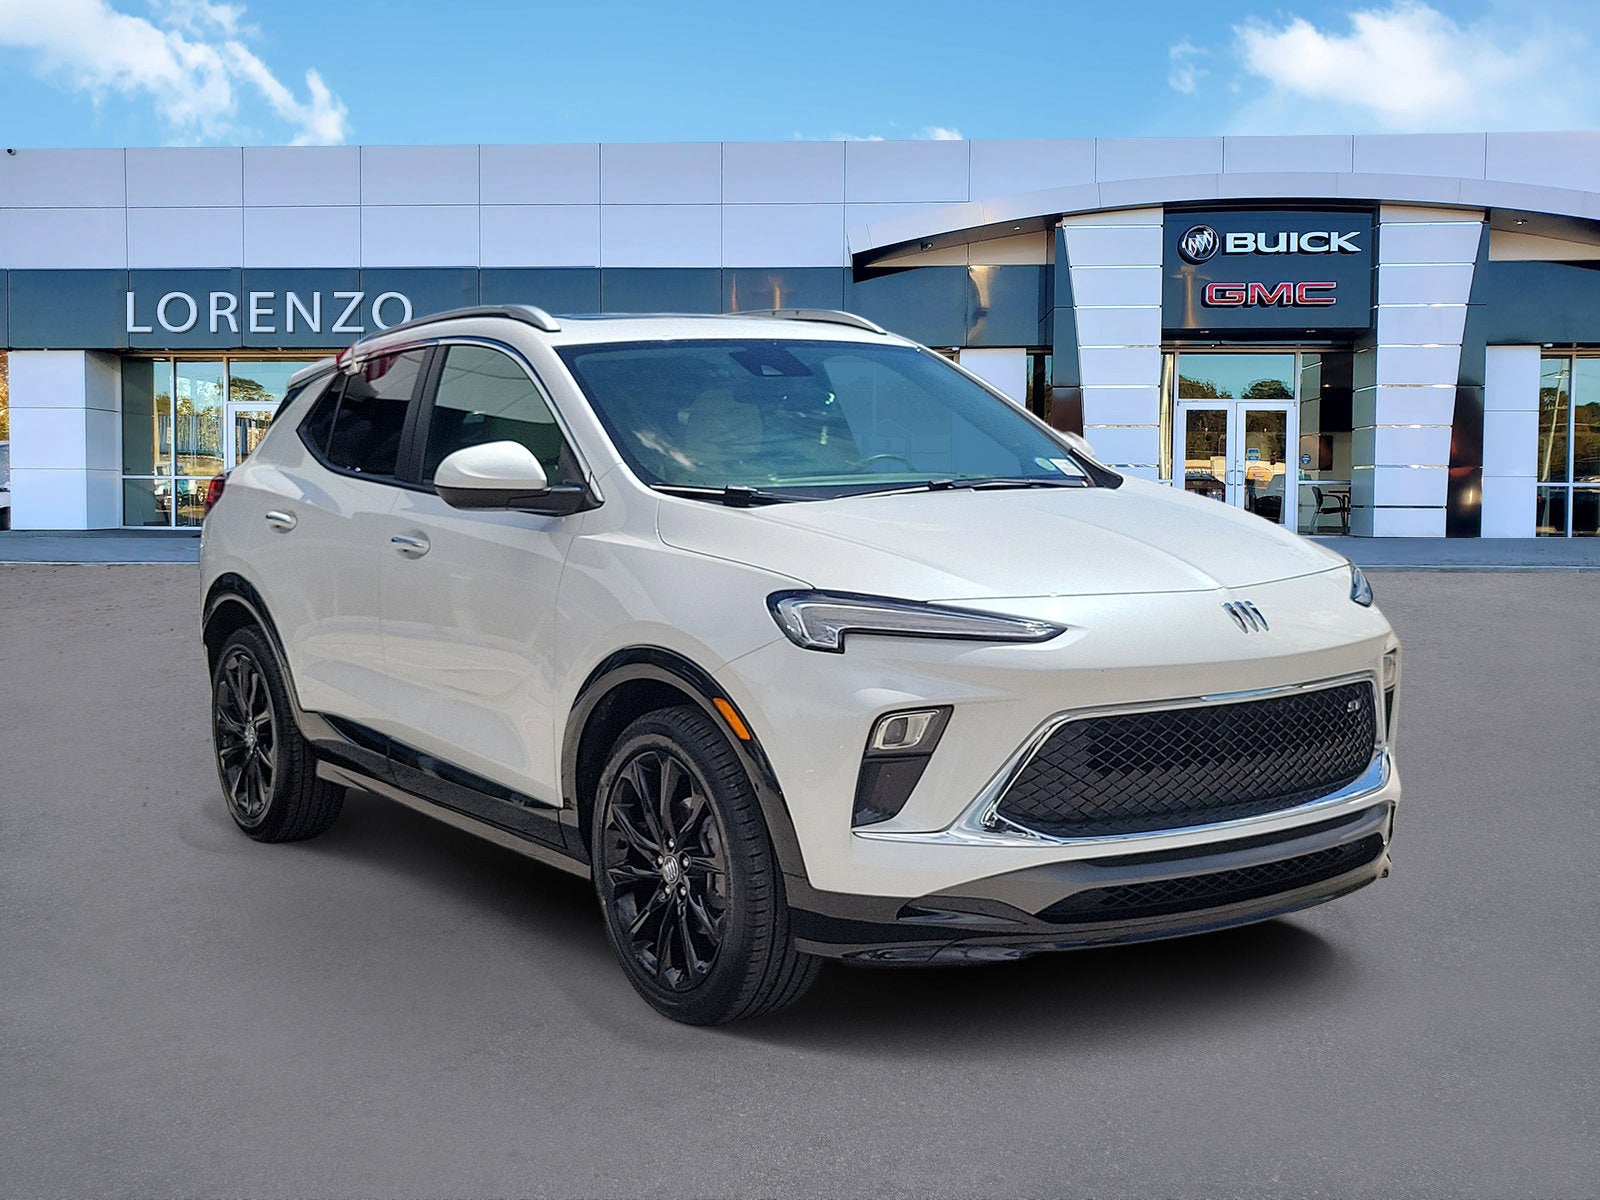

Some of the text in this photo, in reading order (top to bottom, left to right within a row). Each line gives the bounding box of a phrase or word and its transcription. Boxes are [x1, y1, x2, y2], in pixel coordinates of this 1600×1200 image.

[1225, 231, 1362, 253] BUICK
[1205, 282, 1337, 305] GMC
[126, 291, 414, 333] LORENZO
